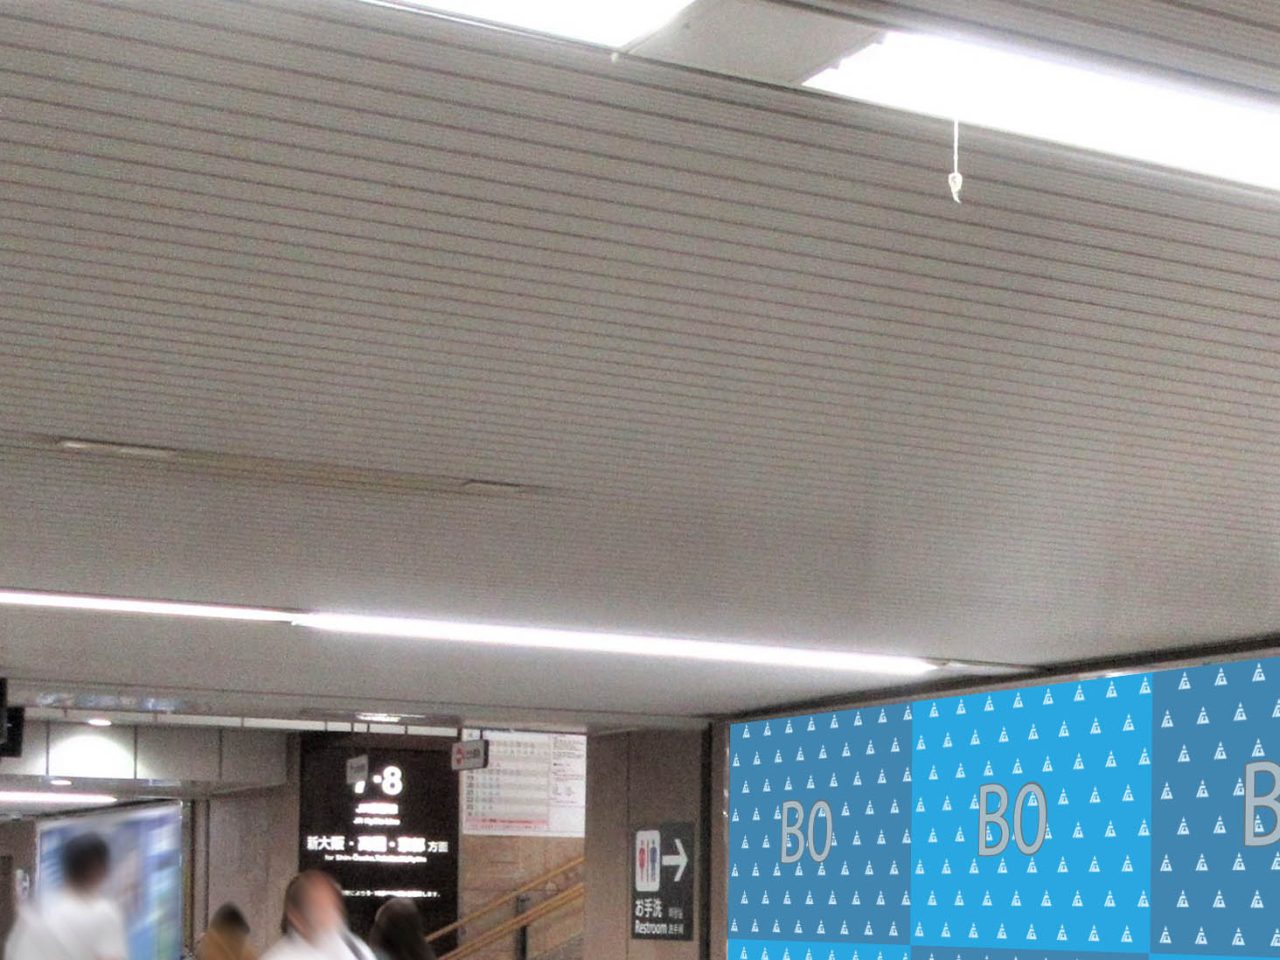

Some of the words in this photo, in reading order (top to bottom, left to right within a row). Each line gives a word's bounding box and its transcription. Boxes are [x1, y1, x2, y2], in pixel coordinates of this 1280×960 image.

[635, 898, 663, 918] お手洗
[635, 920, 667, 935] Restroom
